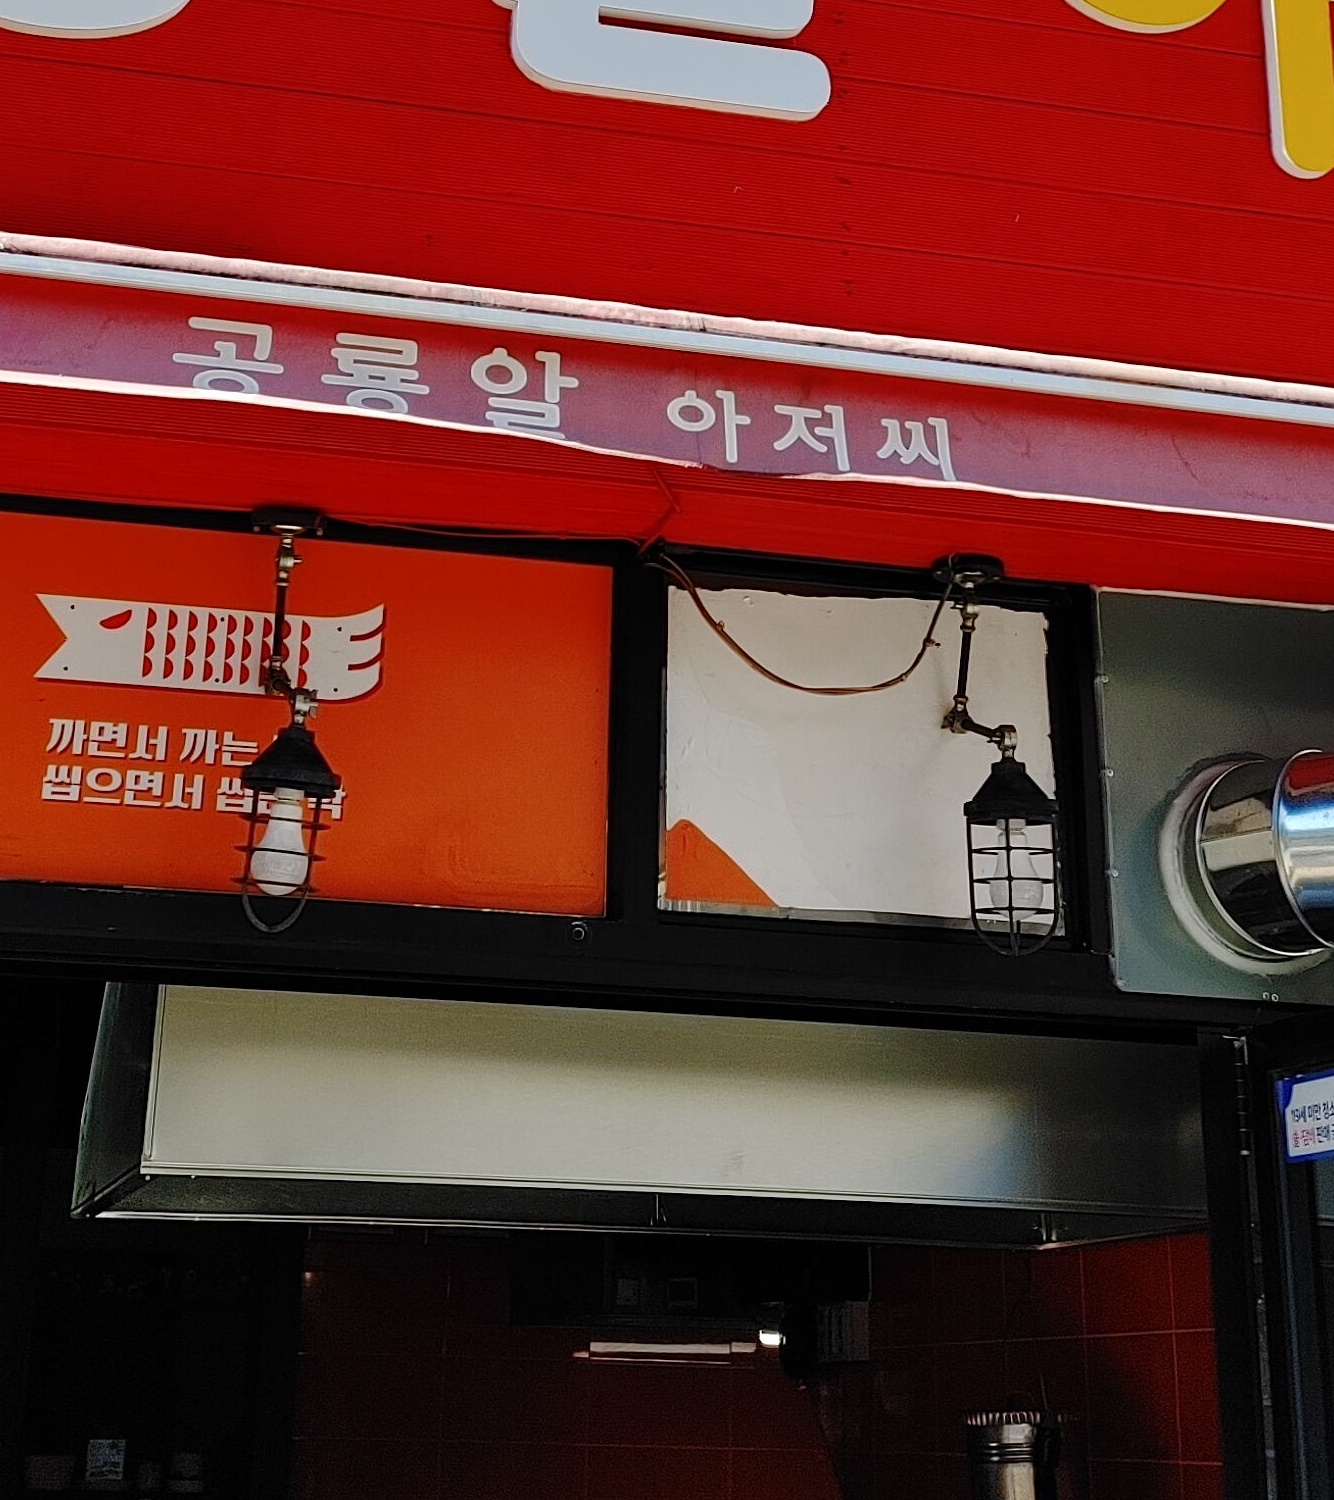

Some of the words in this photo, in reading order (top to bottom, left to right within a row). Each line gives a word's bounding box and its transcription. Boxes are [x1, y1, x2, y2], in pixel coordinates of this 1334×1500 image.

[172, 316, 579, 440] 공룡알
[667, 389, 959, 482] 아저씨
[46, 719, 167, 762] 까면서
[180, 728, 259, 766] 까는
[42, 765, 204, 810] 씹으면서
